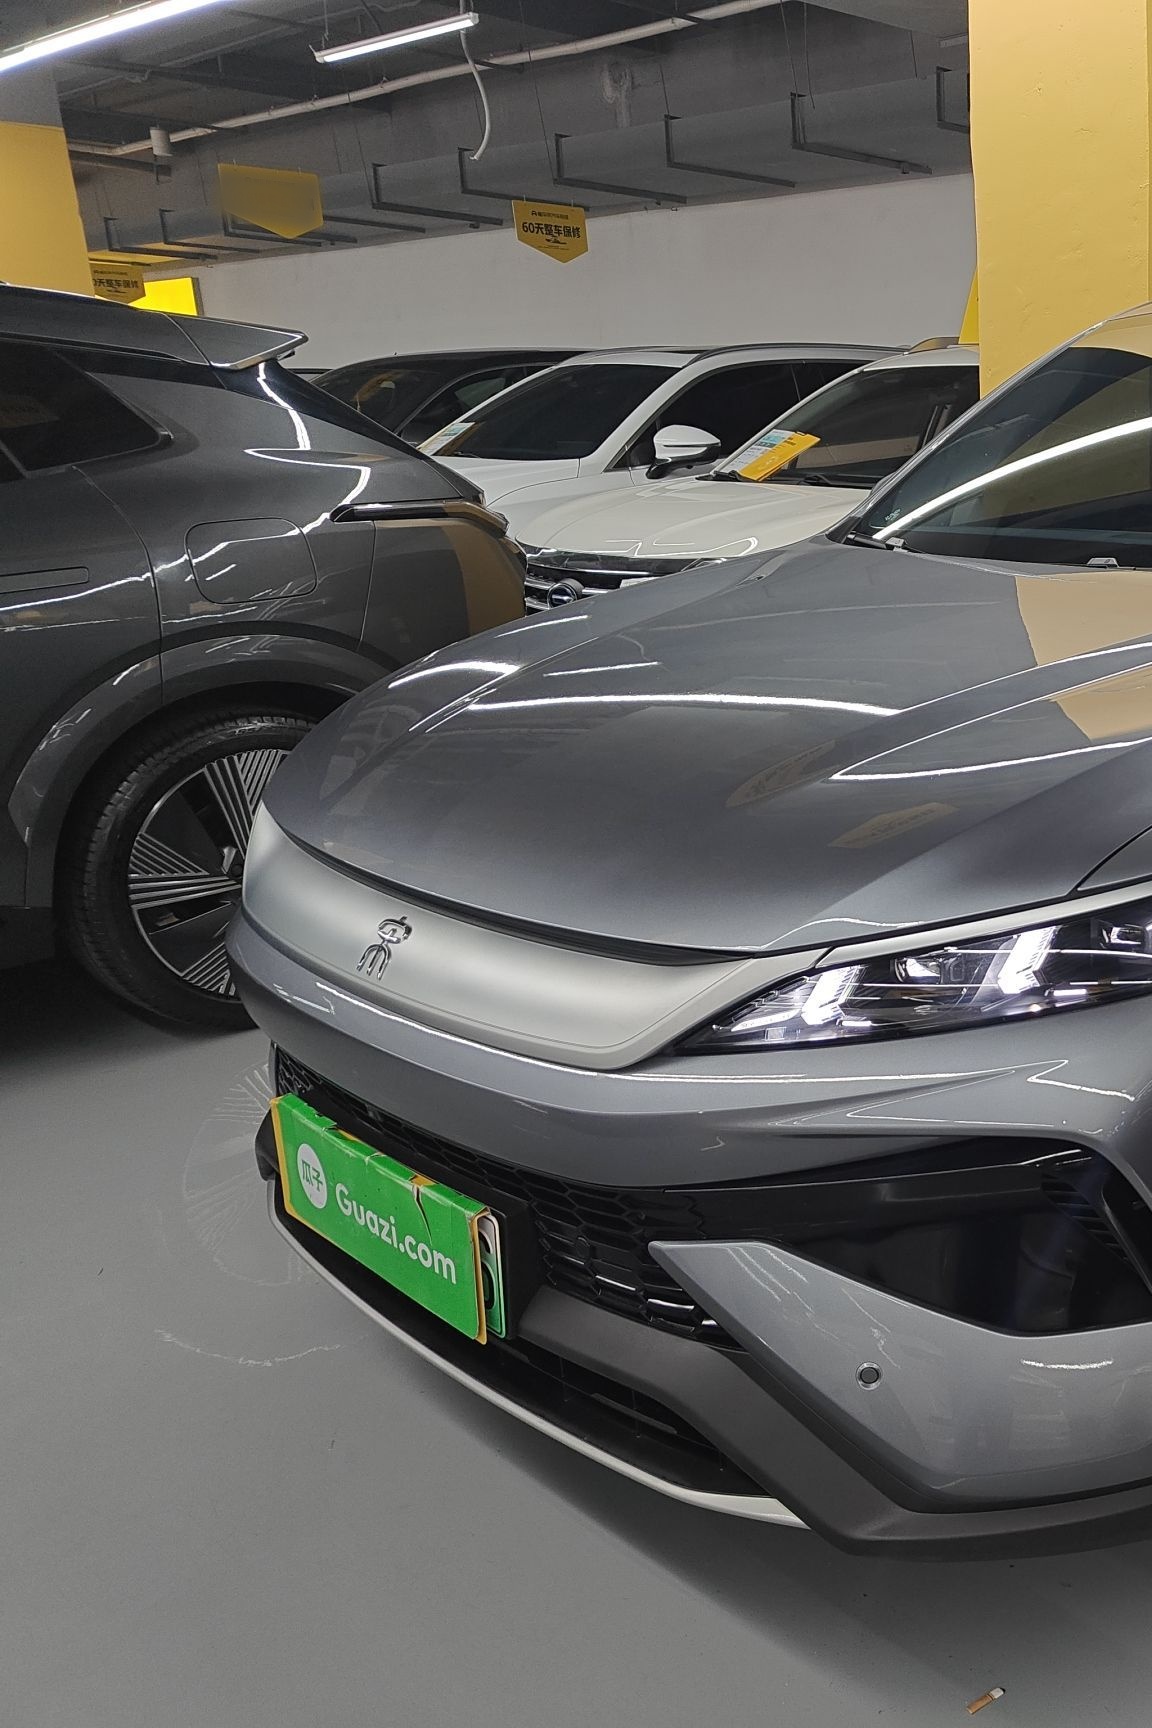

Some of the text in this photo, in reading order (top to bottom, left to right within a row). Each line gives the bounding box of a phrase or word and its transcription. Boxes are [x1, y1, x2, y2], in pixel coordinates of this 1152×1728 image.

[522, 221, 581, 239] 60天整车保修
[301, 1159, 324, 1193] 瓜子
[335, 1182, 457, 1285] Guazi.com
